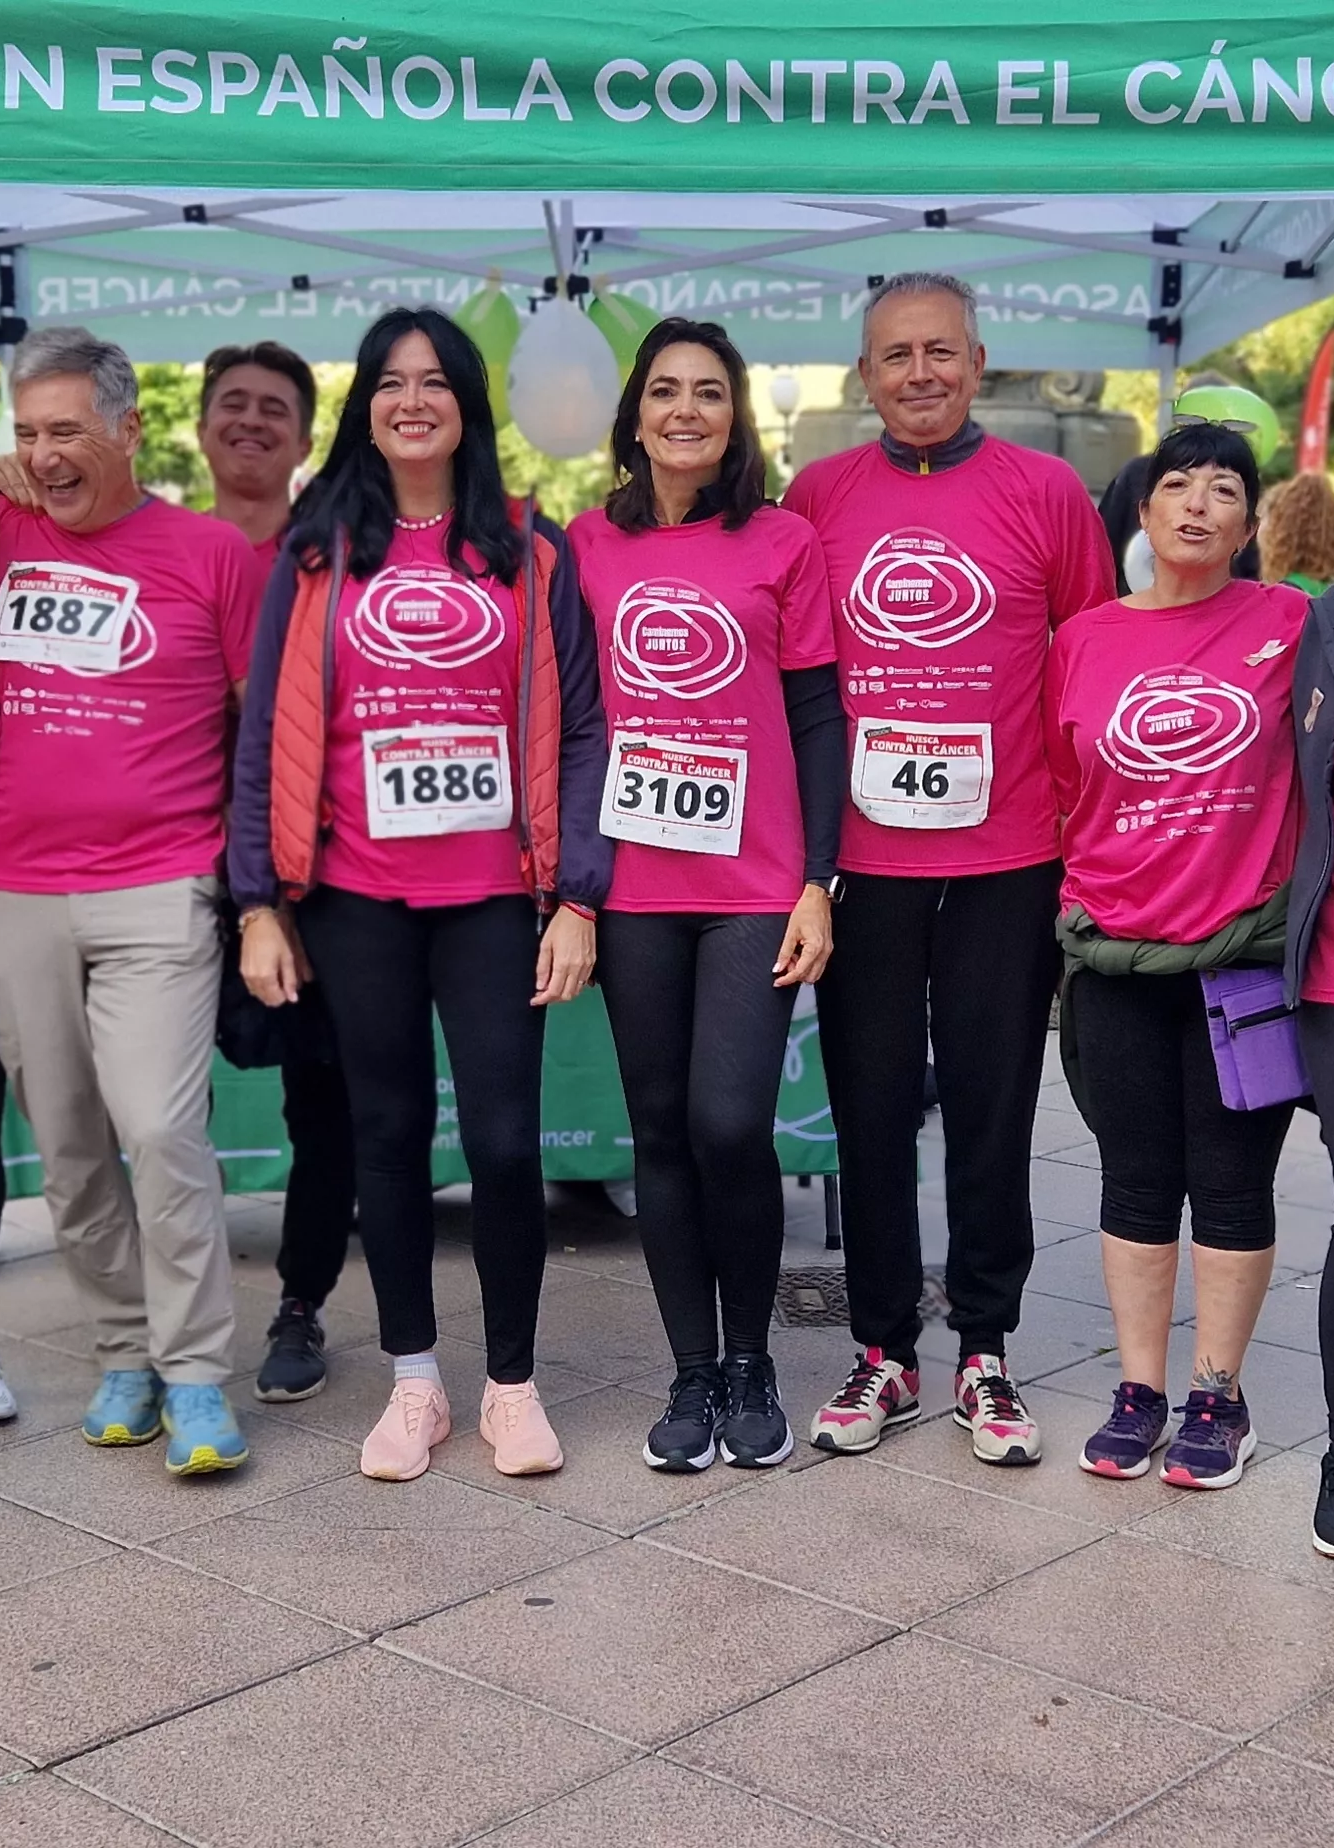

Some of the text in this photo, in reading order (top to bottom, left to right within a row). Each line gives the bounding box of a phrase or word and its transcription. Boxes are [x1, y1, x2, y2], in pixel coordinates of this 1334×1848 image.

[96, 36, 573, 121] ESPAÑOLA
[594, 58, 970, 125] CONTRA
[996, 60, 1099, 124] EL
[14, 580, 55, 590] CONTRA
[58, 582, 69, 592] EL
[9, 595, 116, 637] 1887
[1148, 716, 1193, 734] JUNTOS
[871, 740, 977, 755] CONTRA EL CÁNCER
[906, 735, 940, 744] HUESCA
[381, 749, 430, 760] CONTRA
[433, 748, 445, 758] EL
[662, 751, 695, 764] HUESCA
[626, 754, 731, 779] CONTRA EL CÁNCER
[383, 763, 498, 805] 1886
[891, 760, 949, 799] 46
[617, 771, 730, 822] 3109
